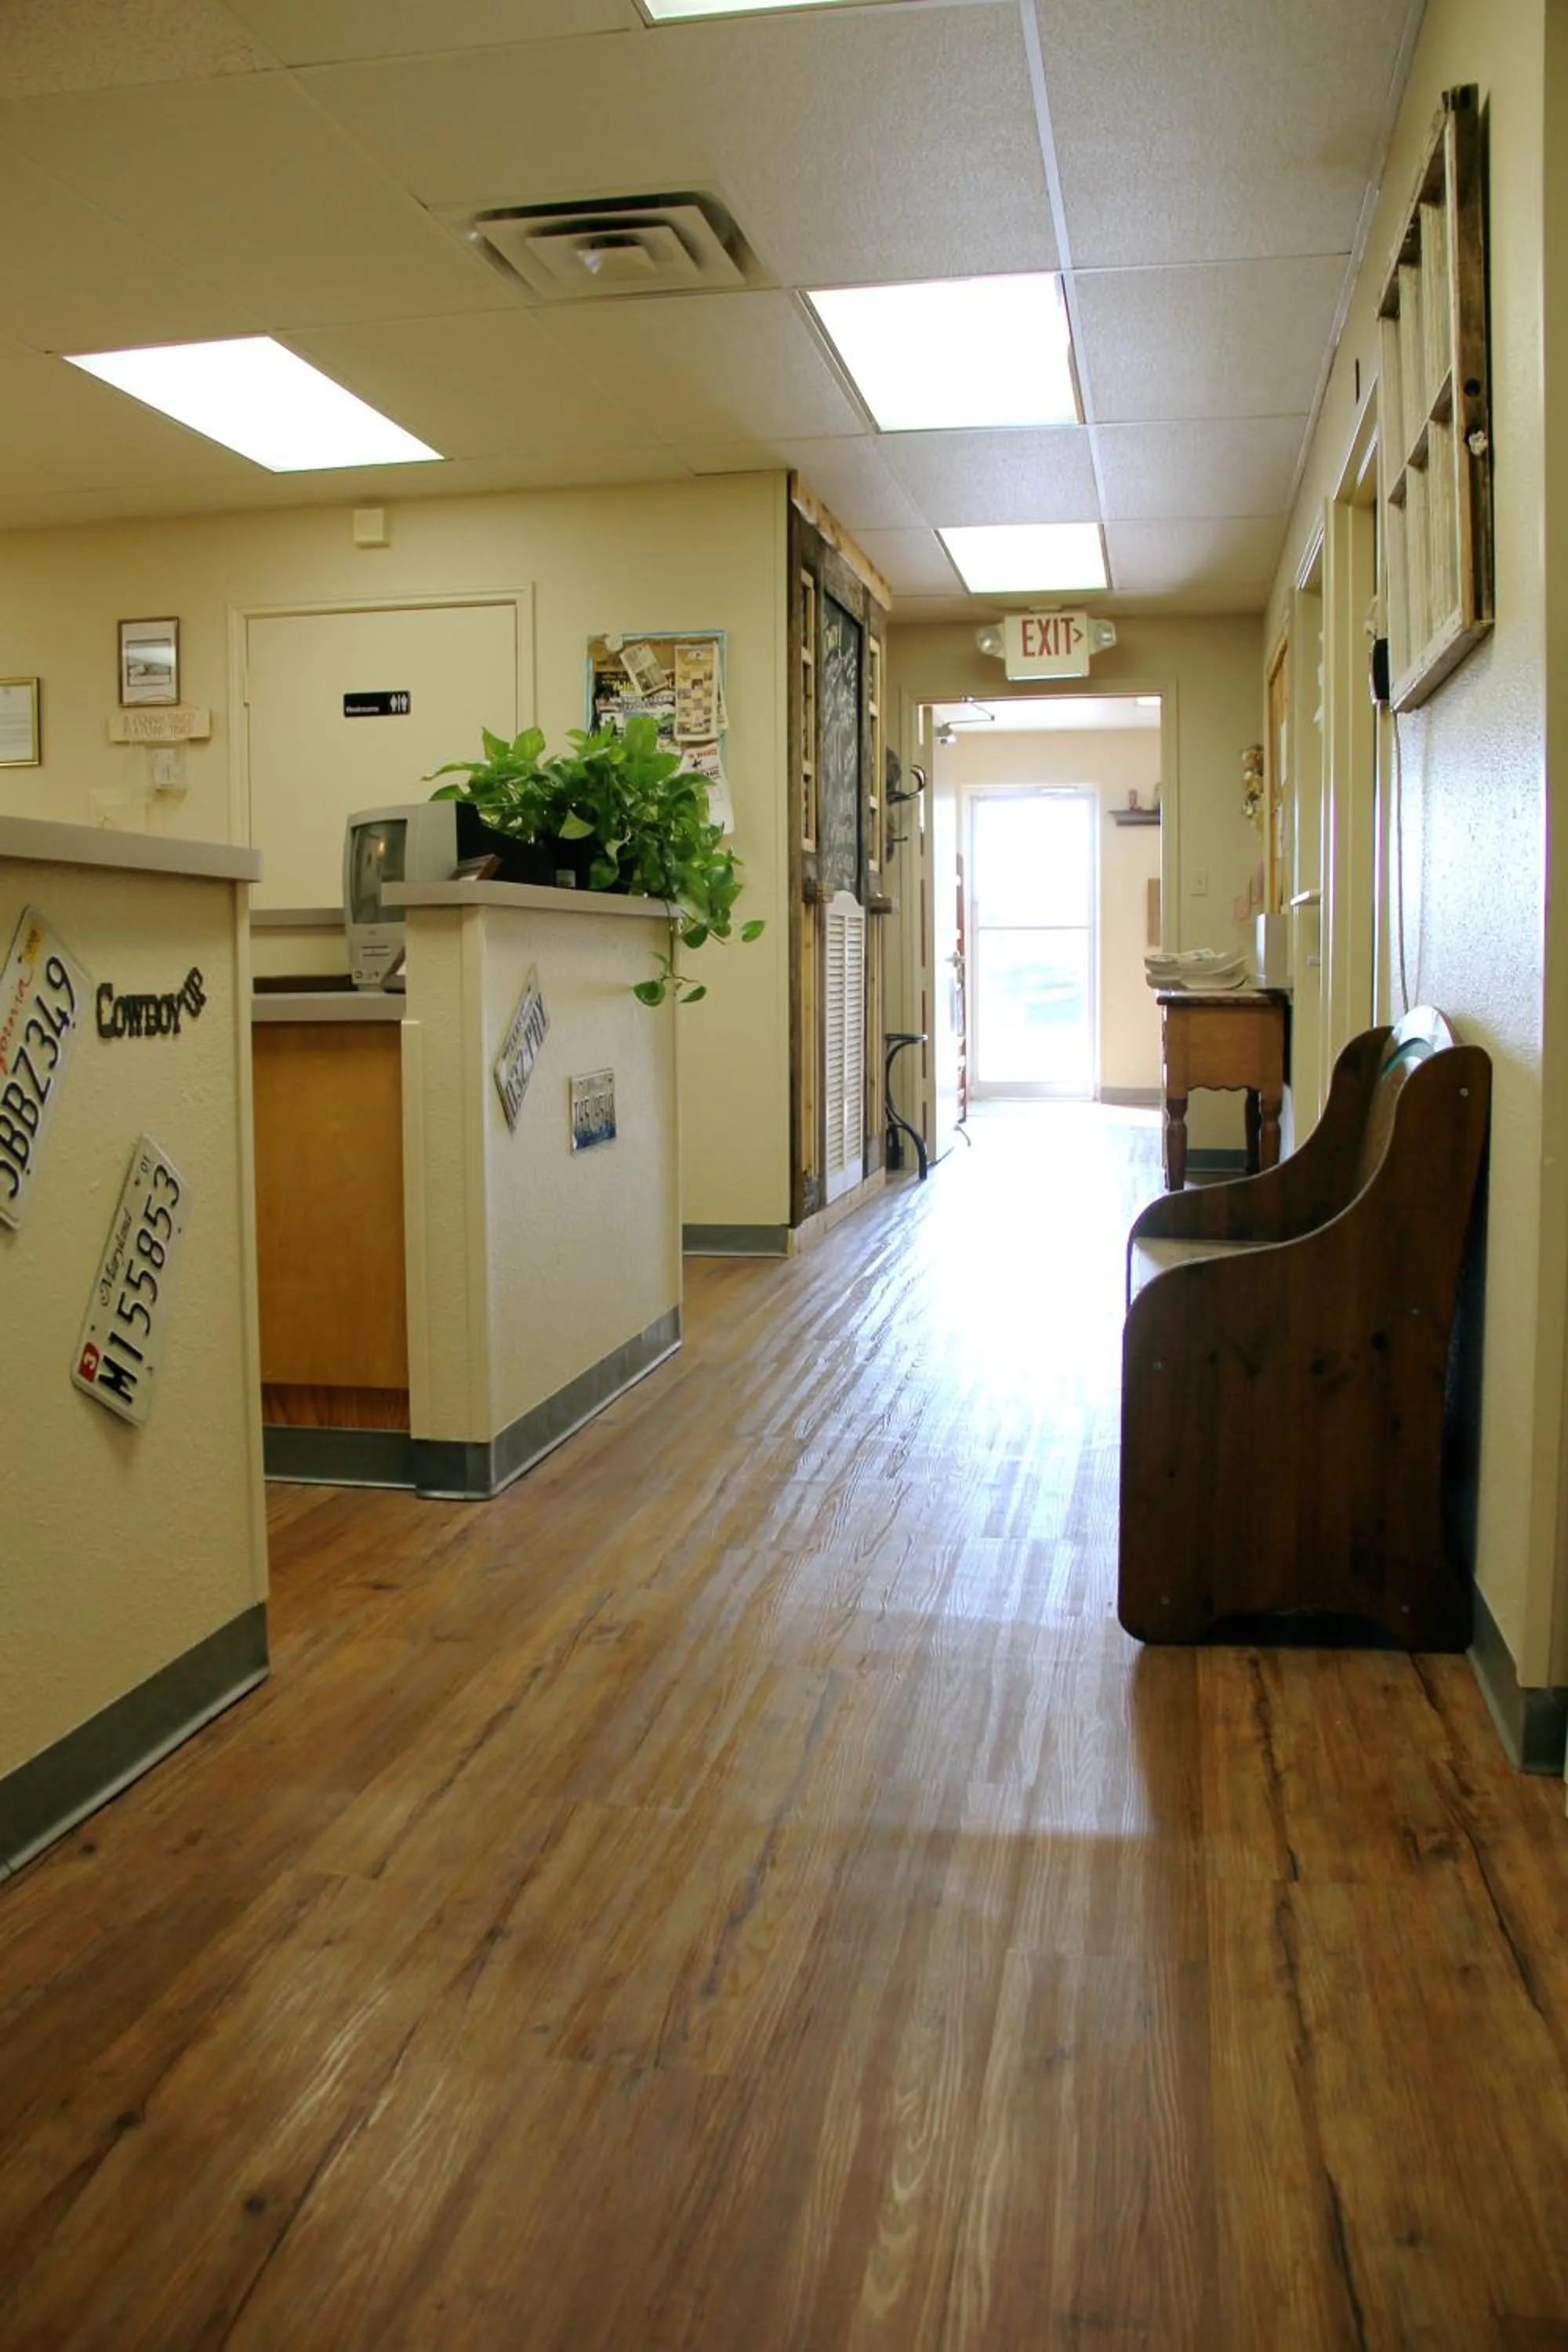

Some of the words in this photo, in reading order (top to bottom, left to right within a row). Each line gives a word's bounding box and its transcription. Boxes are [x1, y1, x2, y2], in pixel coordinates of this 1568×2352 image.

[1022, 617, 1075, 657] EXIT
[96, 982, 184, 1039] COWBOY
[182, 966, 207, 1018] UP
[100, 1206, 132, 1307] Maryland
